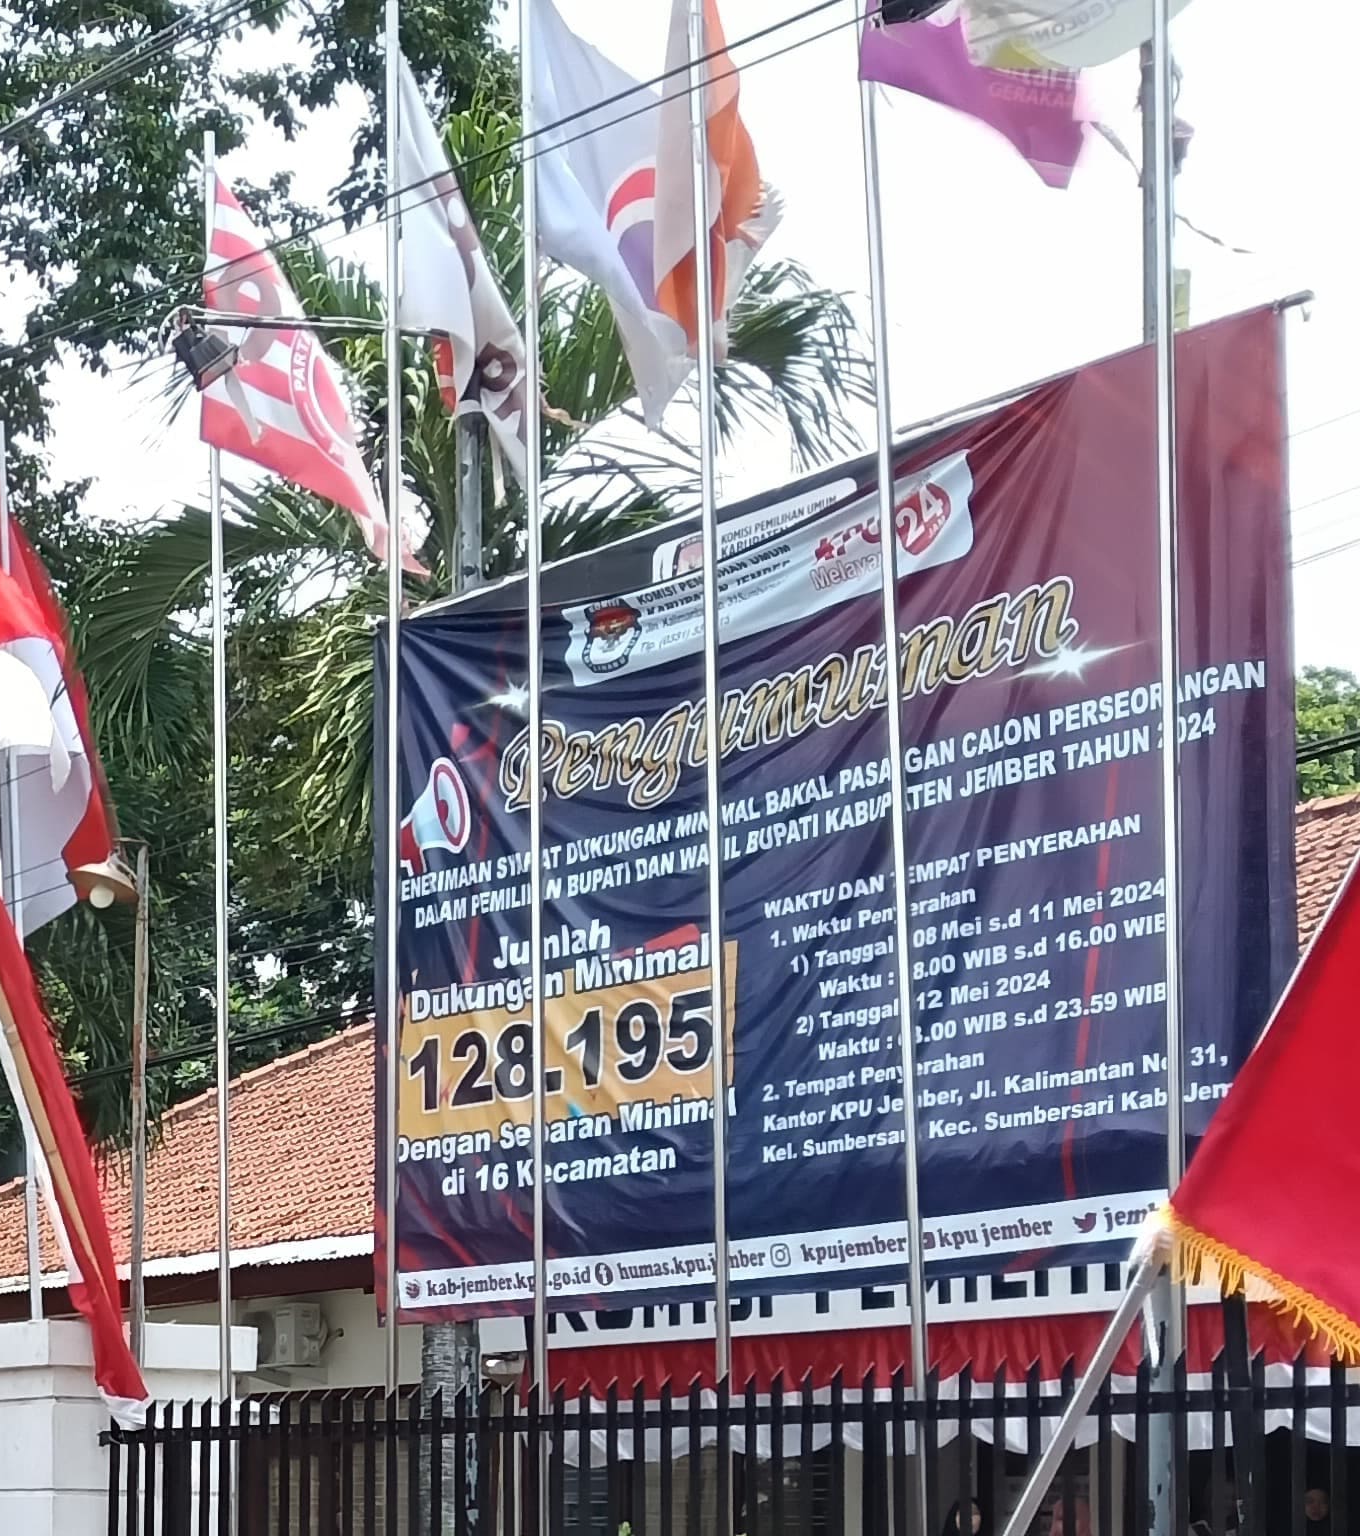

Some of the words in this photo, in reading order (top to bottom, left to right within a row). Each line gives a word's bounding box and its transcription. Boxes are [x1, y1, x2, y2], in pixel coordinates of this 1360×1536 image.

[721, 519, 752, 545] KOMISI
[755, 505, 806, 533] PEMILIHAN
[896, 481, 944, 548] 24
[637, 580, 677, 605] KOMISI
[810, 552, 882, 592] Melaya
[499, 575, 1079, 813] Pengumuman
[400, 860, 492, 901] ENERIMAAN
[496, 845, 562, 879] SYAAT
[566, 819, 671, 865] DUKUNGAN
[675, 796, 761, 838] MINMAL
[765, 775, 834, 818] BAKAL
[838, 735, 956, 799] PASAGAN
[961, 711, 1042, 760] CALON
[415, 898, 466, 929] DALAM
[471, 877, 562, 918] PEMILIN
[567, 861, 632, 900] BUPATI
[636, 852, 675, 882] DAN
[680, 835, 741, 874] WAIL
[745, 807, 820, 853] BUPATI
[960, 754, 1057, 798] JEMBER
[1062, 725, 1151, 772] TAHUN
[764, 886, 835, 919] WAKTU
[837, 873, 885, 903] DAN
[889, 851, 971, 886] EMPAT
[977, 814, 1142, 868] PENYERAHAN
[770, 928, 787, 949] 1.
[792, 915, 852, 945] Waktu
[858, 887, 977, 928] Penerahan
[790, 956, 809, 976] 1)
[814, 935, 895, 970] Tanggal
[912, 927, 937, 949] 08
[941, 916, 982, 942] Mei
[988, 908, 1022, 933] s.d
[1028, 900, 1055, 923] 11
[1063, 889, 1104, 918] Mei
[1109, 877, 1166, 909] 2024
[411, 972, 564, 1022] Dukungan
[574, 933, 711, 992] Minimal
[818, 970, 883, 1000] Waktu
[912, 955, 956, 981] 8.00
[964, 944, 1008, 972] WIB
[1014, 937, 1048, 963] s.d
[1055, 921, 1117, 952] 16.00
[796, 1015, 815, 1037] 2)
[819, 997, 899, 1030] Tanggal
[915, 989, 944, 1011] 12
[950, 978, 989, 1007] Mei
[995, 968, 1052, 997] 2024
[818, 1035, 881, 1062] Waktu
[964, 1010, 1008, 1036] WIB
[1014, 1003, 1048, 1028] s.d
[1054, 990, 1118, 1023] 23.59
[1124, 982, 1167, 1009] WIB
[407, 985, 714, 1115] 128.195
[763, 1083, 780, 1102] 2.
[784, 1064, 856, 1101] Tempat
[763, 1109, 826, 1133] Kantor
[829, 1099, 874, 1123] KPU
[970, 1079, 998, 1101] Jl.
[1004, 1057, 1135, 1095] Kalimantan
[1190, 1043, 1229, 1069] 31,
[398, 1131, 491, 1165] Dengan
[762, 1142, 798, 1164] Kel.
[929, 1117, 978, 1140] Kec.
[984, 1096, 1114, 1134] Sumbersari
[442, 1168, 466, 1197] di
[475, 1163, 509, 1193] 16
[427, 1265, 591, 1302] kab-jember.kp.go.id
[617, 1249, 765, 1284] humas.kpu.jmber
[800, 1232, 908, 1266] kpujember
[939, 1226, 978, 1251] kpu
[982, 1217, 1054, 1248] jember
